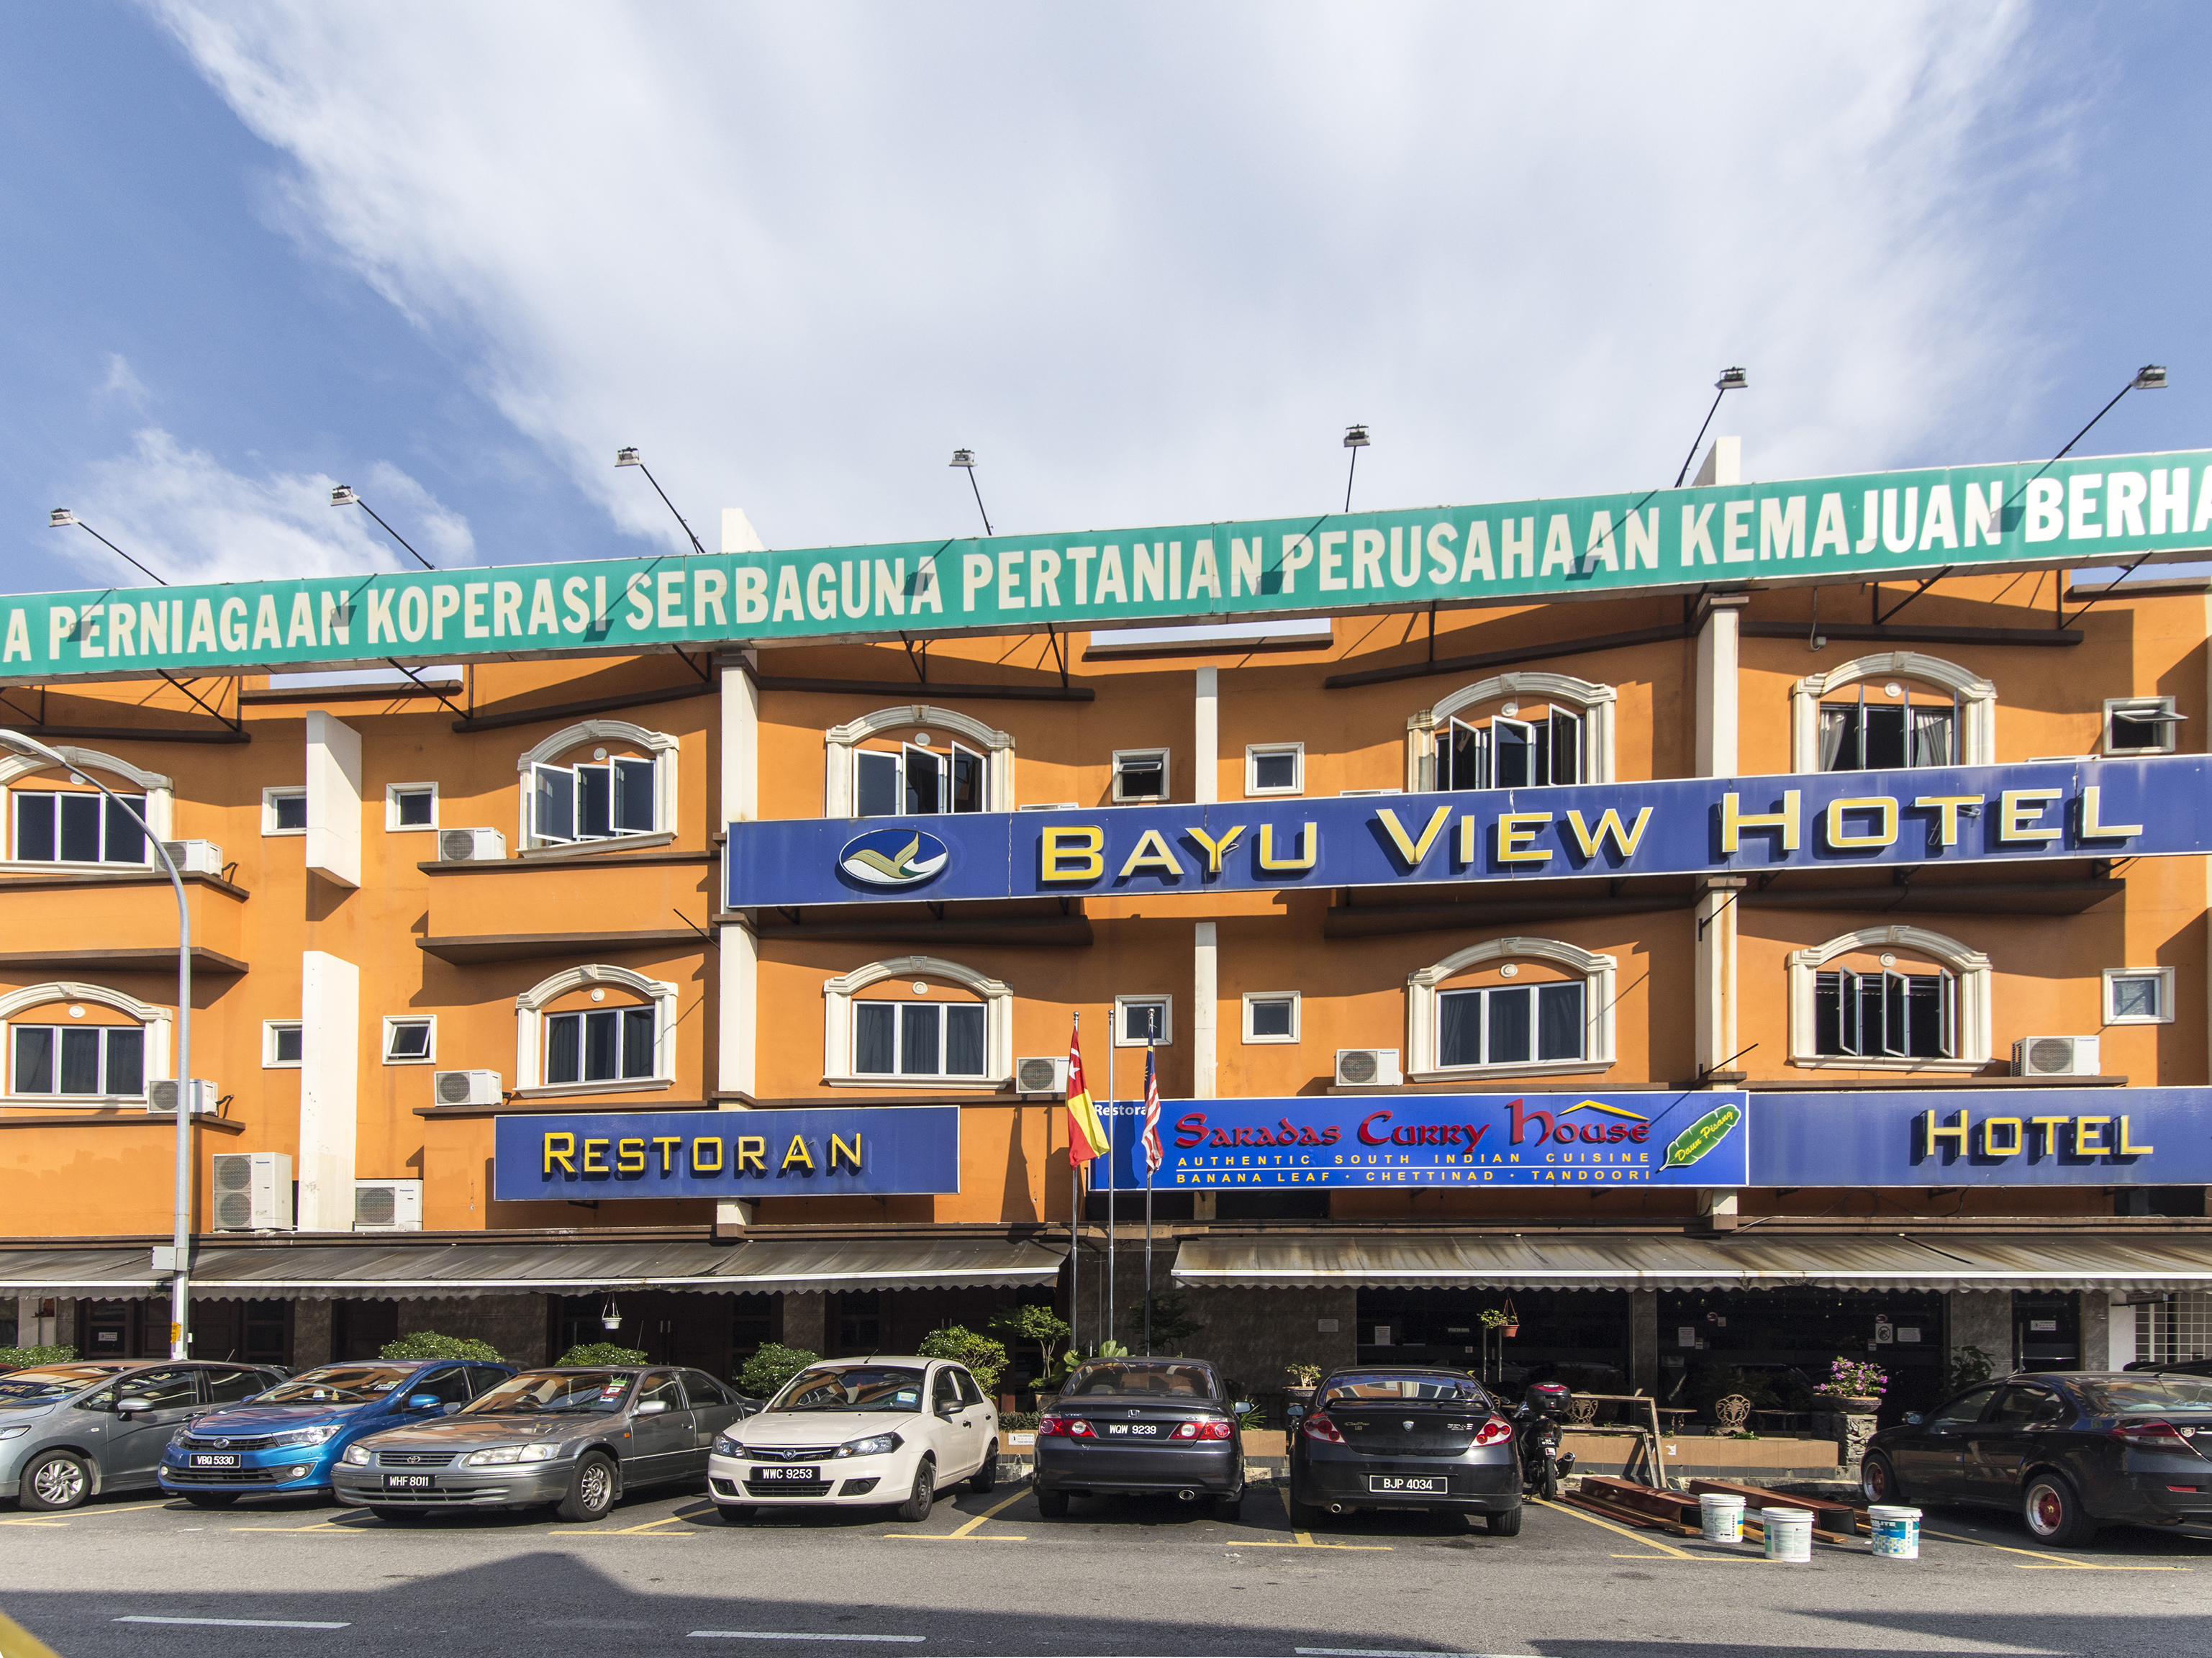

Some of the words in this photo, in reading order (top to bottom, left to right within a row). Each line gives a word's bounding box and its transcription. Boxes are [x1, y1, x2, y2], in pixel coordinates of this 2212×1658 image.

[48, 590, 350, 660] PERNIAGAAN
[368, 576, 607, 644] KOPERASI
[625, 556, 943, 631] SERBAGUNA
[963, 536, 1263, 612] PERTANIAN
[1282, 507, 1659, 594] PERUSAHAAN
[1680, 480, 2003, 567] KEMAJUAN
[1041, 821, 1318, 883] BAYU
[1374, 805, 1654, 866] VIEW
[1721, 786, 2144, 852] HOTEL
[1094, 1104, 1146, 1116] Restora
[1174, 1112, 1342, 1149] Saradas
[1358, 1110, 1491, 1156] Curry
[1505, 1097, 1651, 1148] House
[1925, 1109, 2154, 1156] HOTEL
[1674, 1138, 1702, 1161] Daun
[1700, 1111, 1733, 1139] Pisang
[543, 1131, 862, 1174] RESTORAN
[1178, 1154, 1310, 1166] AUTHENTIC
[1335, 1154, 1409, 1164] SOUTH
[1434, 1153, 1519, 1164] INDIAN
[1546, 1152, 1649, 1163] CUISINE
[1177, 1172, 1261, 1184] BANANA
[1277, 1172, 1331, 1182] LEAF
[1366, 1171, 1493, 1182] CHETTINAD
[1531, 1170, 1650, 1181] TANDOORI
[1109, 1425, 1128, 1434] WQW
[1132, 1425, 1157, 1435] 9239
[196, 1455, 212, 1465] VBQ
[213, 1455, 235, 1465] 5330
[763, 1469, 783, 1479] WWC
[786, 1469, 812, 1479] 9253
[389, 1476, 409, 1486] WHF
[409, 1476, 429, 1487] 8011
[1383, 1478, 1404, 1489] BJP
[1406, 1479, 1433, 1490] 4034
